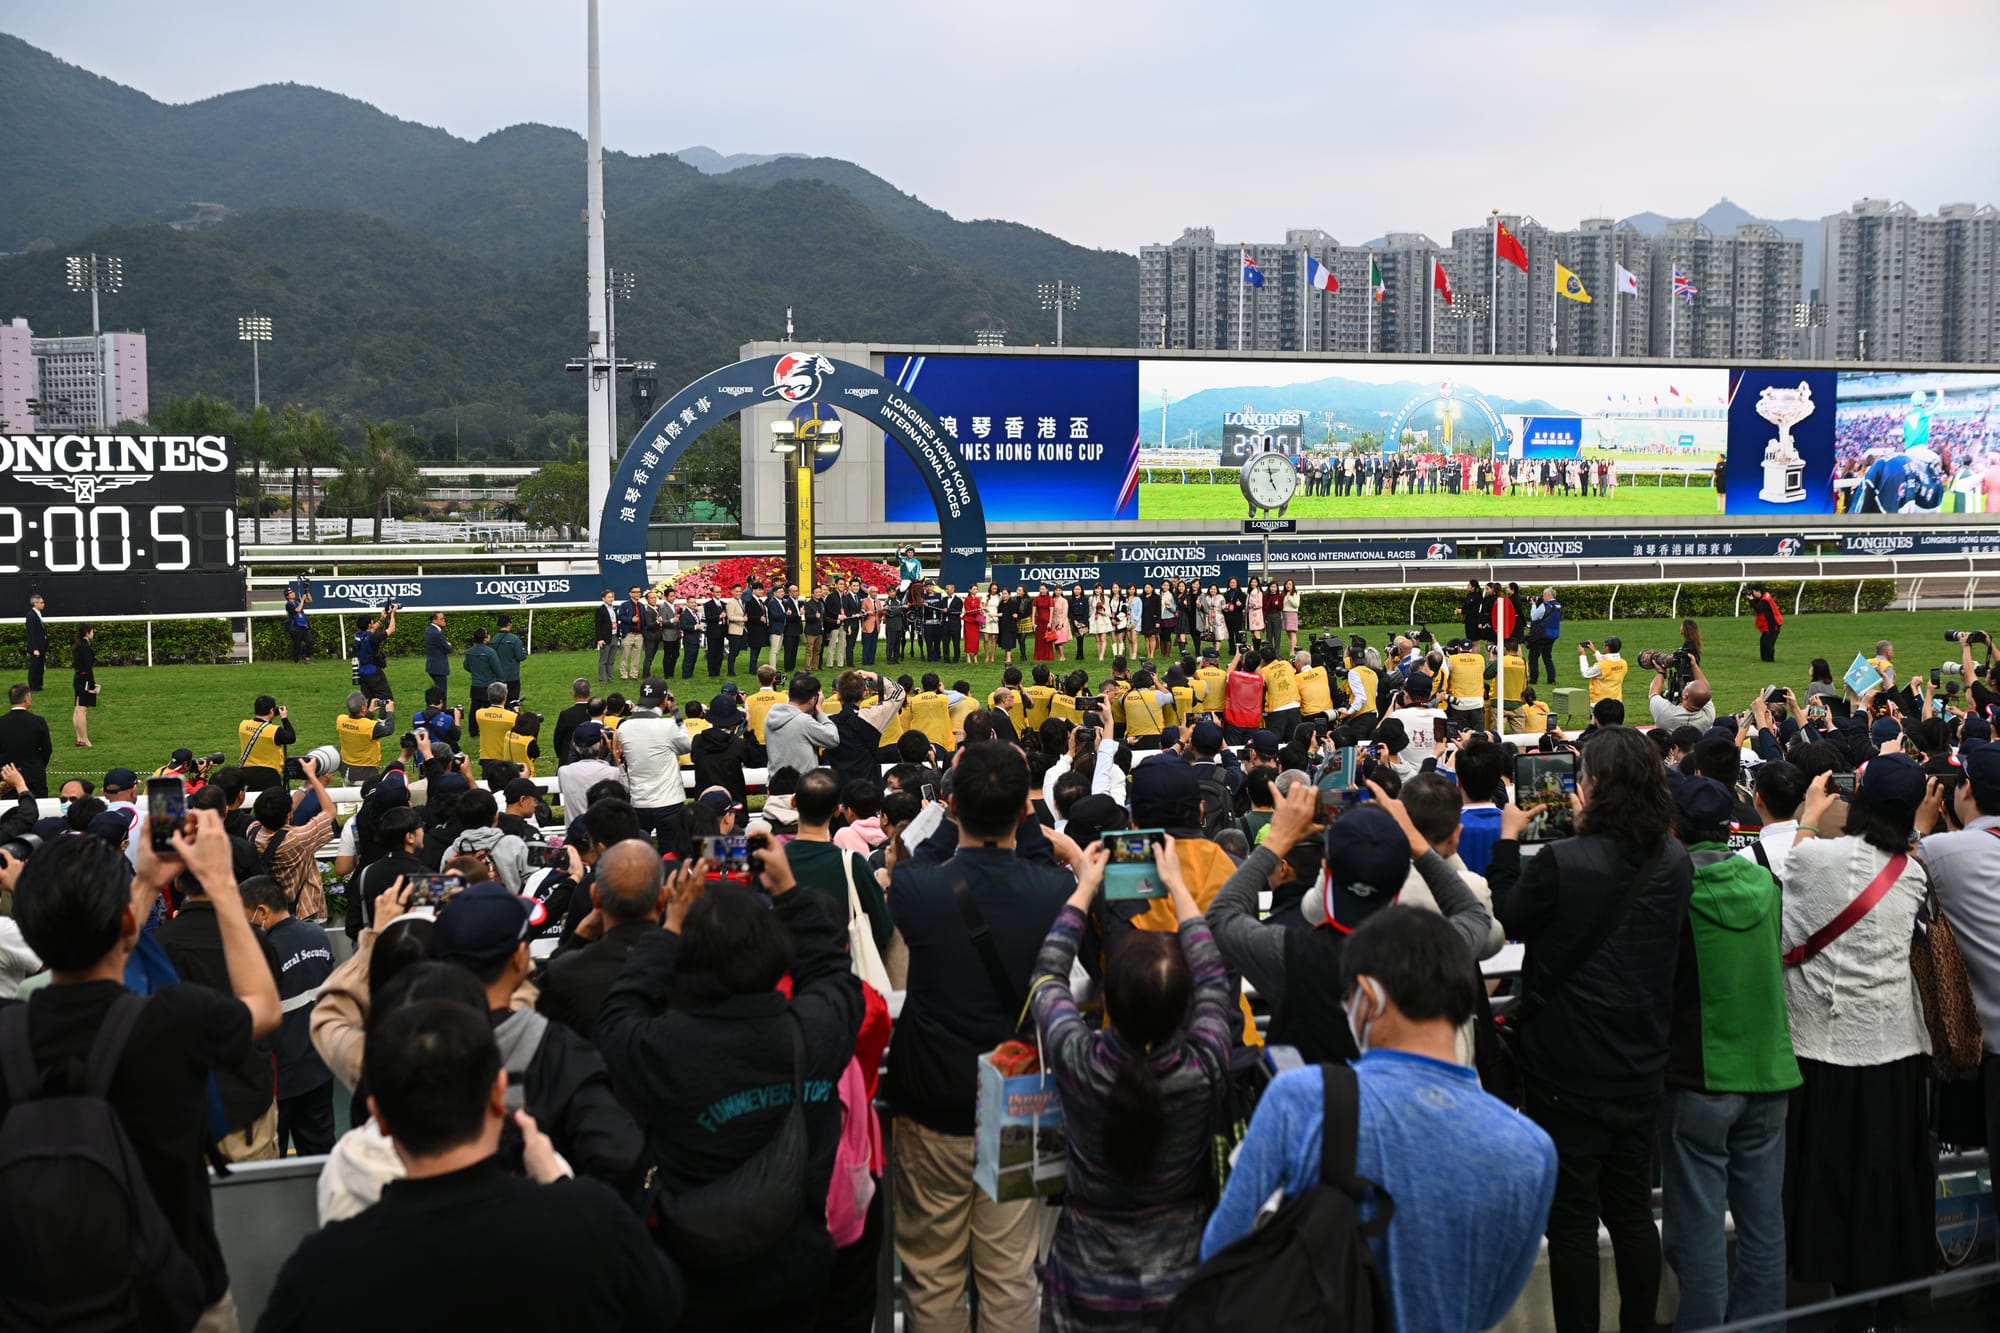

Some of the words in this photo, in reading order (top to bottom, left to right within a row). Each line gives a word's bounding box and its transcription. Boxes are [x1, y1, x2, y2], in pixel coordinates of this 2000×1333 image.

[1224, 412, 1300, 426] LONGINES
[887, 393, 937, 439] LONGINES
[932, 437, 957, 471] HONG
[951, 470, 971, 505] KONG
[996, 443, 1032, 461] HONG
[1037, 443, 1073, 461] KONG
[1078, 443, 1104, 461] CUP
[880, 405, 943, 479] INTERNATIONAL
[941, 478, 961, 519] RACES
[1847, 537, 1914, 550] LONGINES
[1921, 536, 1957, 545] LONGINES
[1958, 536, 1979, 544] HONG
[1980, 535, 2000, 543] KONG
[1121, 547, 1206, 561] LONGINES
[1508, 541, 1583, 555] LONGINES
[1216, 553, 1262, 561] LONGINES
[1291, 552, 1317, 561] KONG
[1318, 551, 1386, 561] INTERNATIONAL
[1387, 550, 1416, 559] RACES
[1020, 567, 1100, 581] LONGINES
[1144, 565, 1221, 579] LONGINES
[323, 583, 422, 599] LONGINES
[476, 579, 570, 595] LONGINES
[484, 711, 503, 719] MEDIA
[342, 723, 360, 731] MEDIA
